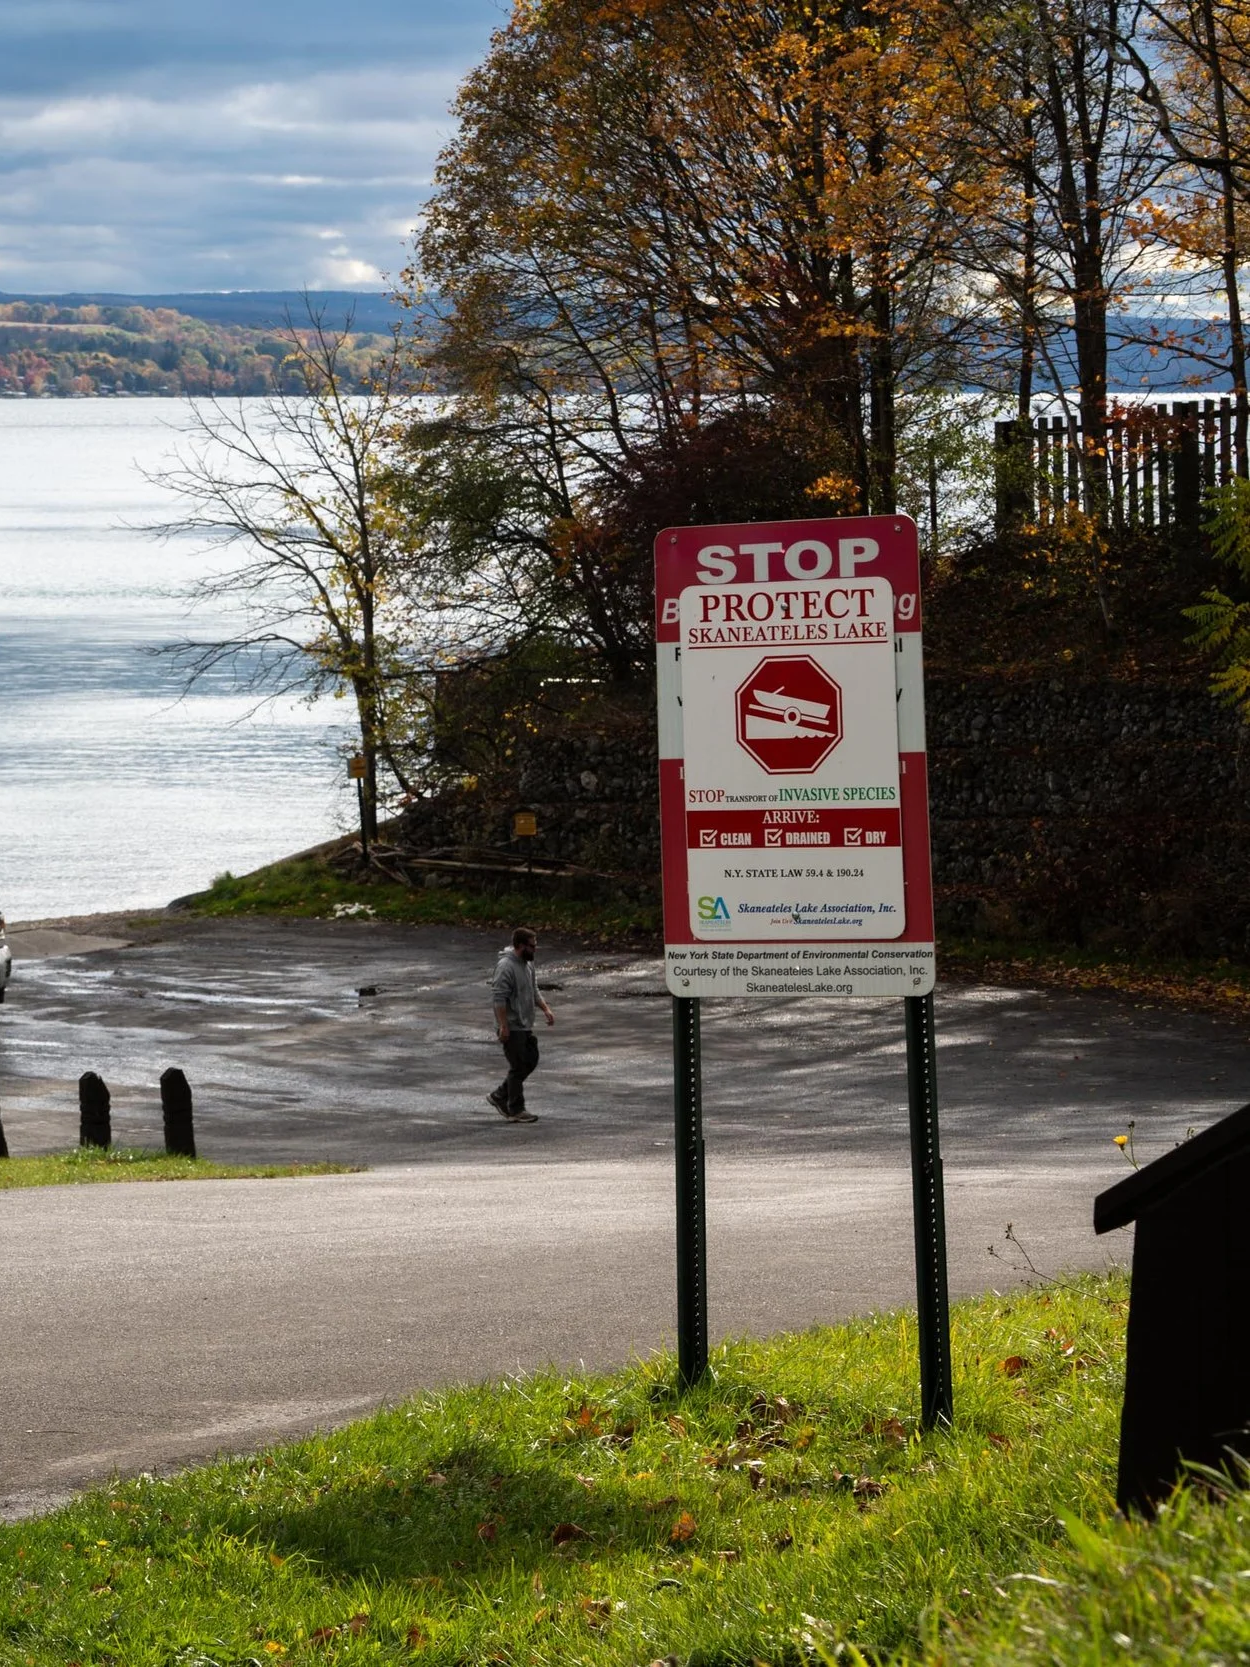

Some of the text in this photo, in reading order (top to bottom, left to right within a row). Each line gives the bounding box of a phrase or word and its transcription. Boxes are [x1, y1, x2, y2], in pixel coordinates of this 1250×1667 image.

[696, 538, 879, 584] STOP
[699, 589, 875, 623] PROTECT
[688, 622, 887, 644] SKANEATELES LAKE
[688, 786, 896, 803] STOP TRANSPORT OF INVASIVE SPECIES
[762, 810, 820, 824] ARRIVE:
[720, 831, 886, 846] CLEAN DRAINED DRY
[724, 868, 864, 878] N.Y. STATE LAW 59.4 & 190.24
[737, 903, 896, 914] Skaneateles Lake Association, Inc.
[668, 949, 933, 961] New York State Department of Environmental Conservation
[673, 965, 928, 979] Courtesy of the Skaneateles Lake Association, Inc.
[746, 982, 853, 994] SkaneatelesLake.org
